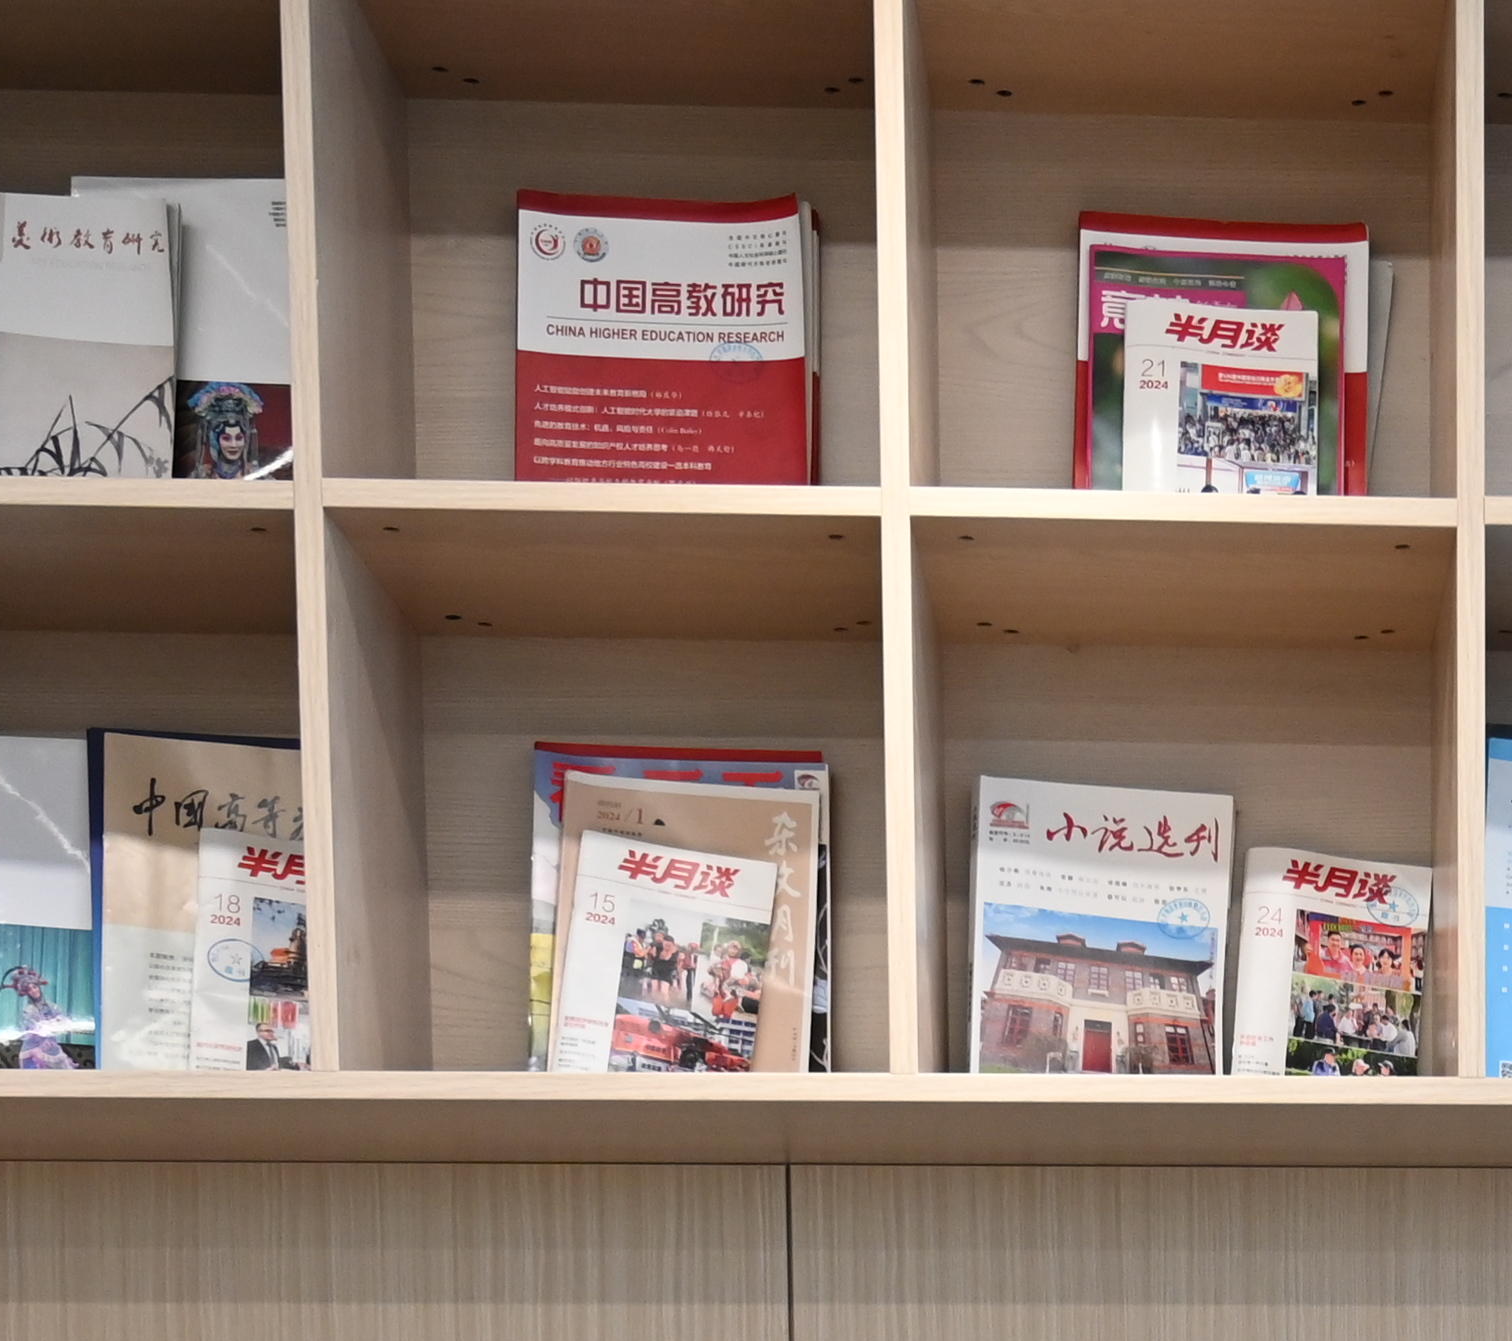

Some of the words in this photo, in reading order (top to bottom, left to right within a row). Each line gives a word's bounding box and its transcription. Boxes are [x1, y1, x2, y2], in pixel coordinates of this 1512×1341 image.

[580, 278, 785, 317] 中国高教研究
[546, 324, 586, 338] CHINA
[590, 328, 637, 341] HIGHER
[641, 330, 714, 342] EDUCATION
[719, 331, 784, 342] RESEARCH
[1165, 312, 1285, 352] 半月谈
[1141, 359, 1166, 377] 21
[1139, 379, 1169, 390] 2024
[1045, 812, 1219, 863] 小说选刊
[618, 849, 741, 898] 半月谈
[1282, 859, 1397, 905] 半月谈
[214, 893, 241, 914] 18
[589, 891, 616, 914] 15
[210, 914, 241, 927] 2024
[586, 912, 616, 926] 2024
[1257, 905, 1284, 926] 24
[1254, 926, 1284, 939] 2024
